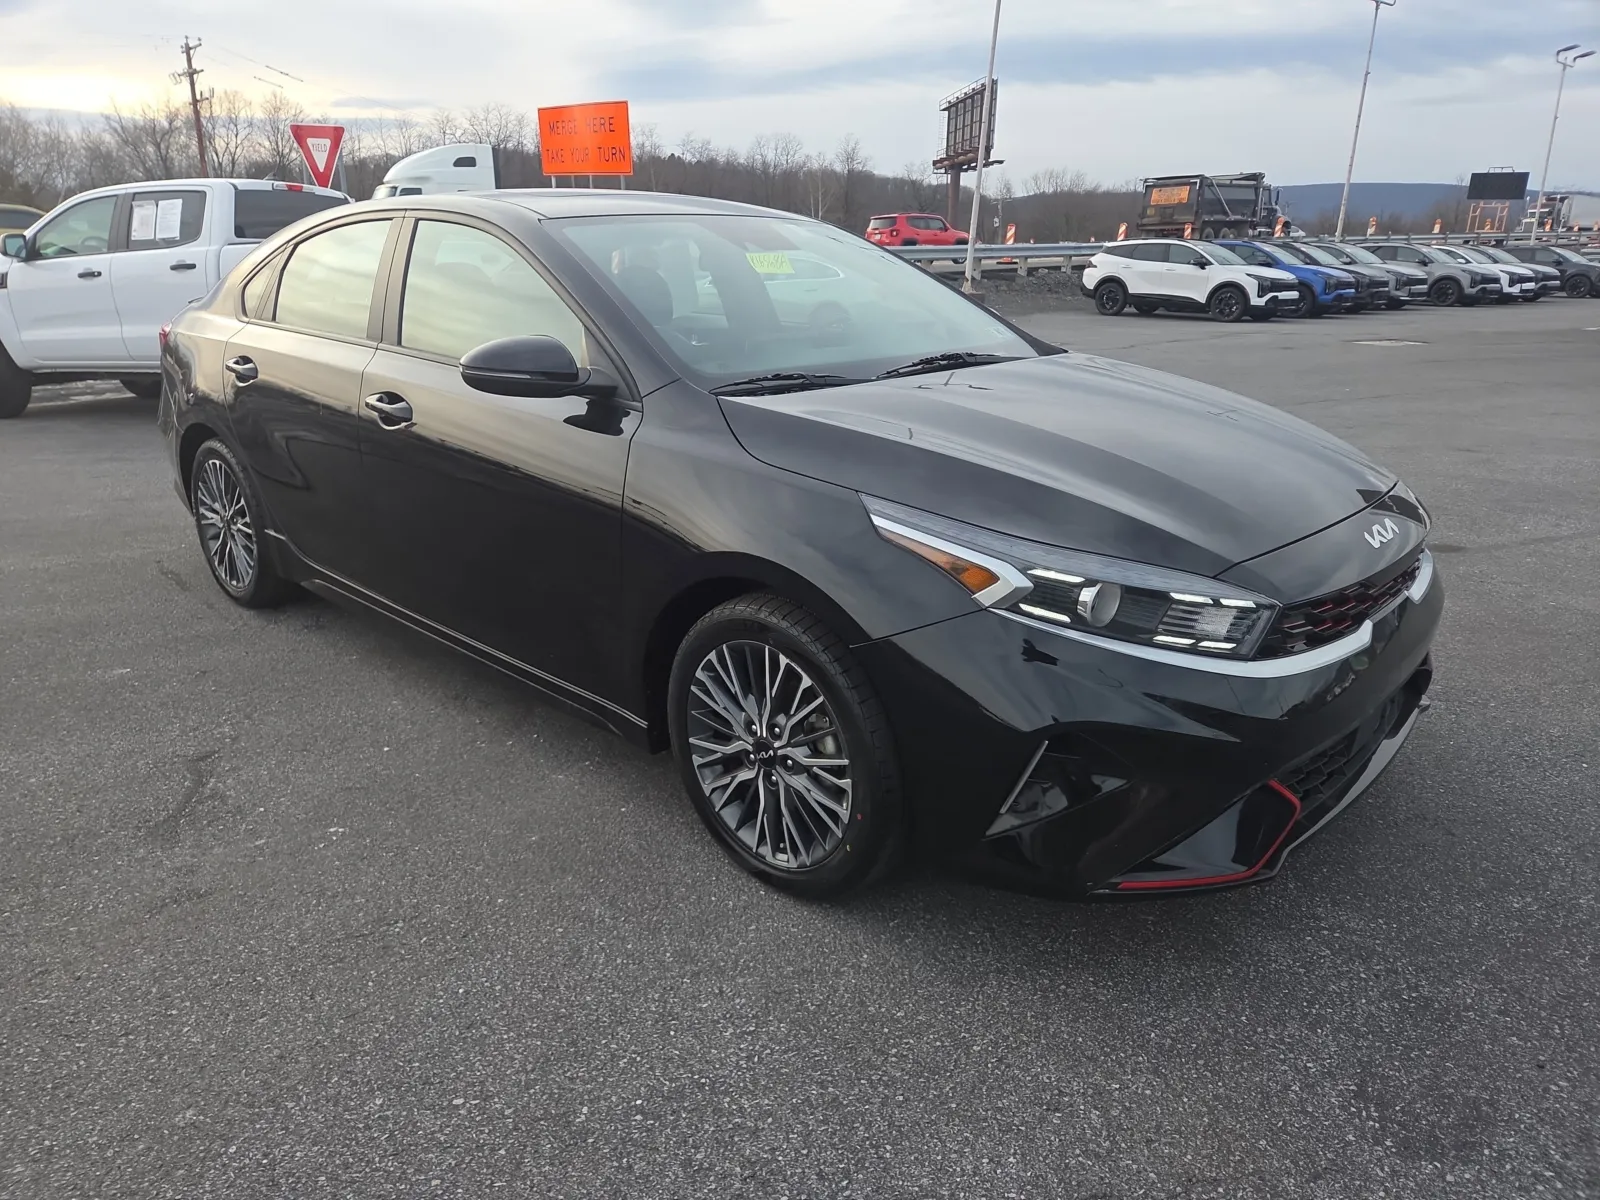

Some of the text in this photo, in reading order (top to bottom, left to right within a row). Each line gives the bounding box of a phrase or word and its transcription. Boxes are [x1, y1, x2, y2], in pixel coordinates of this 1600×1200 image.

[548, 116, 616, 136] MERGE HERE
[312, 143, 328, 153] YIELD
[546, 146, 626, 164] TAKE YOUR TURN
[1363, 517, 1400, 549] KIA
